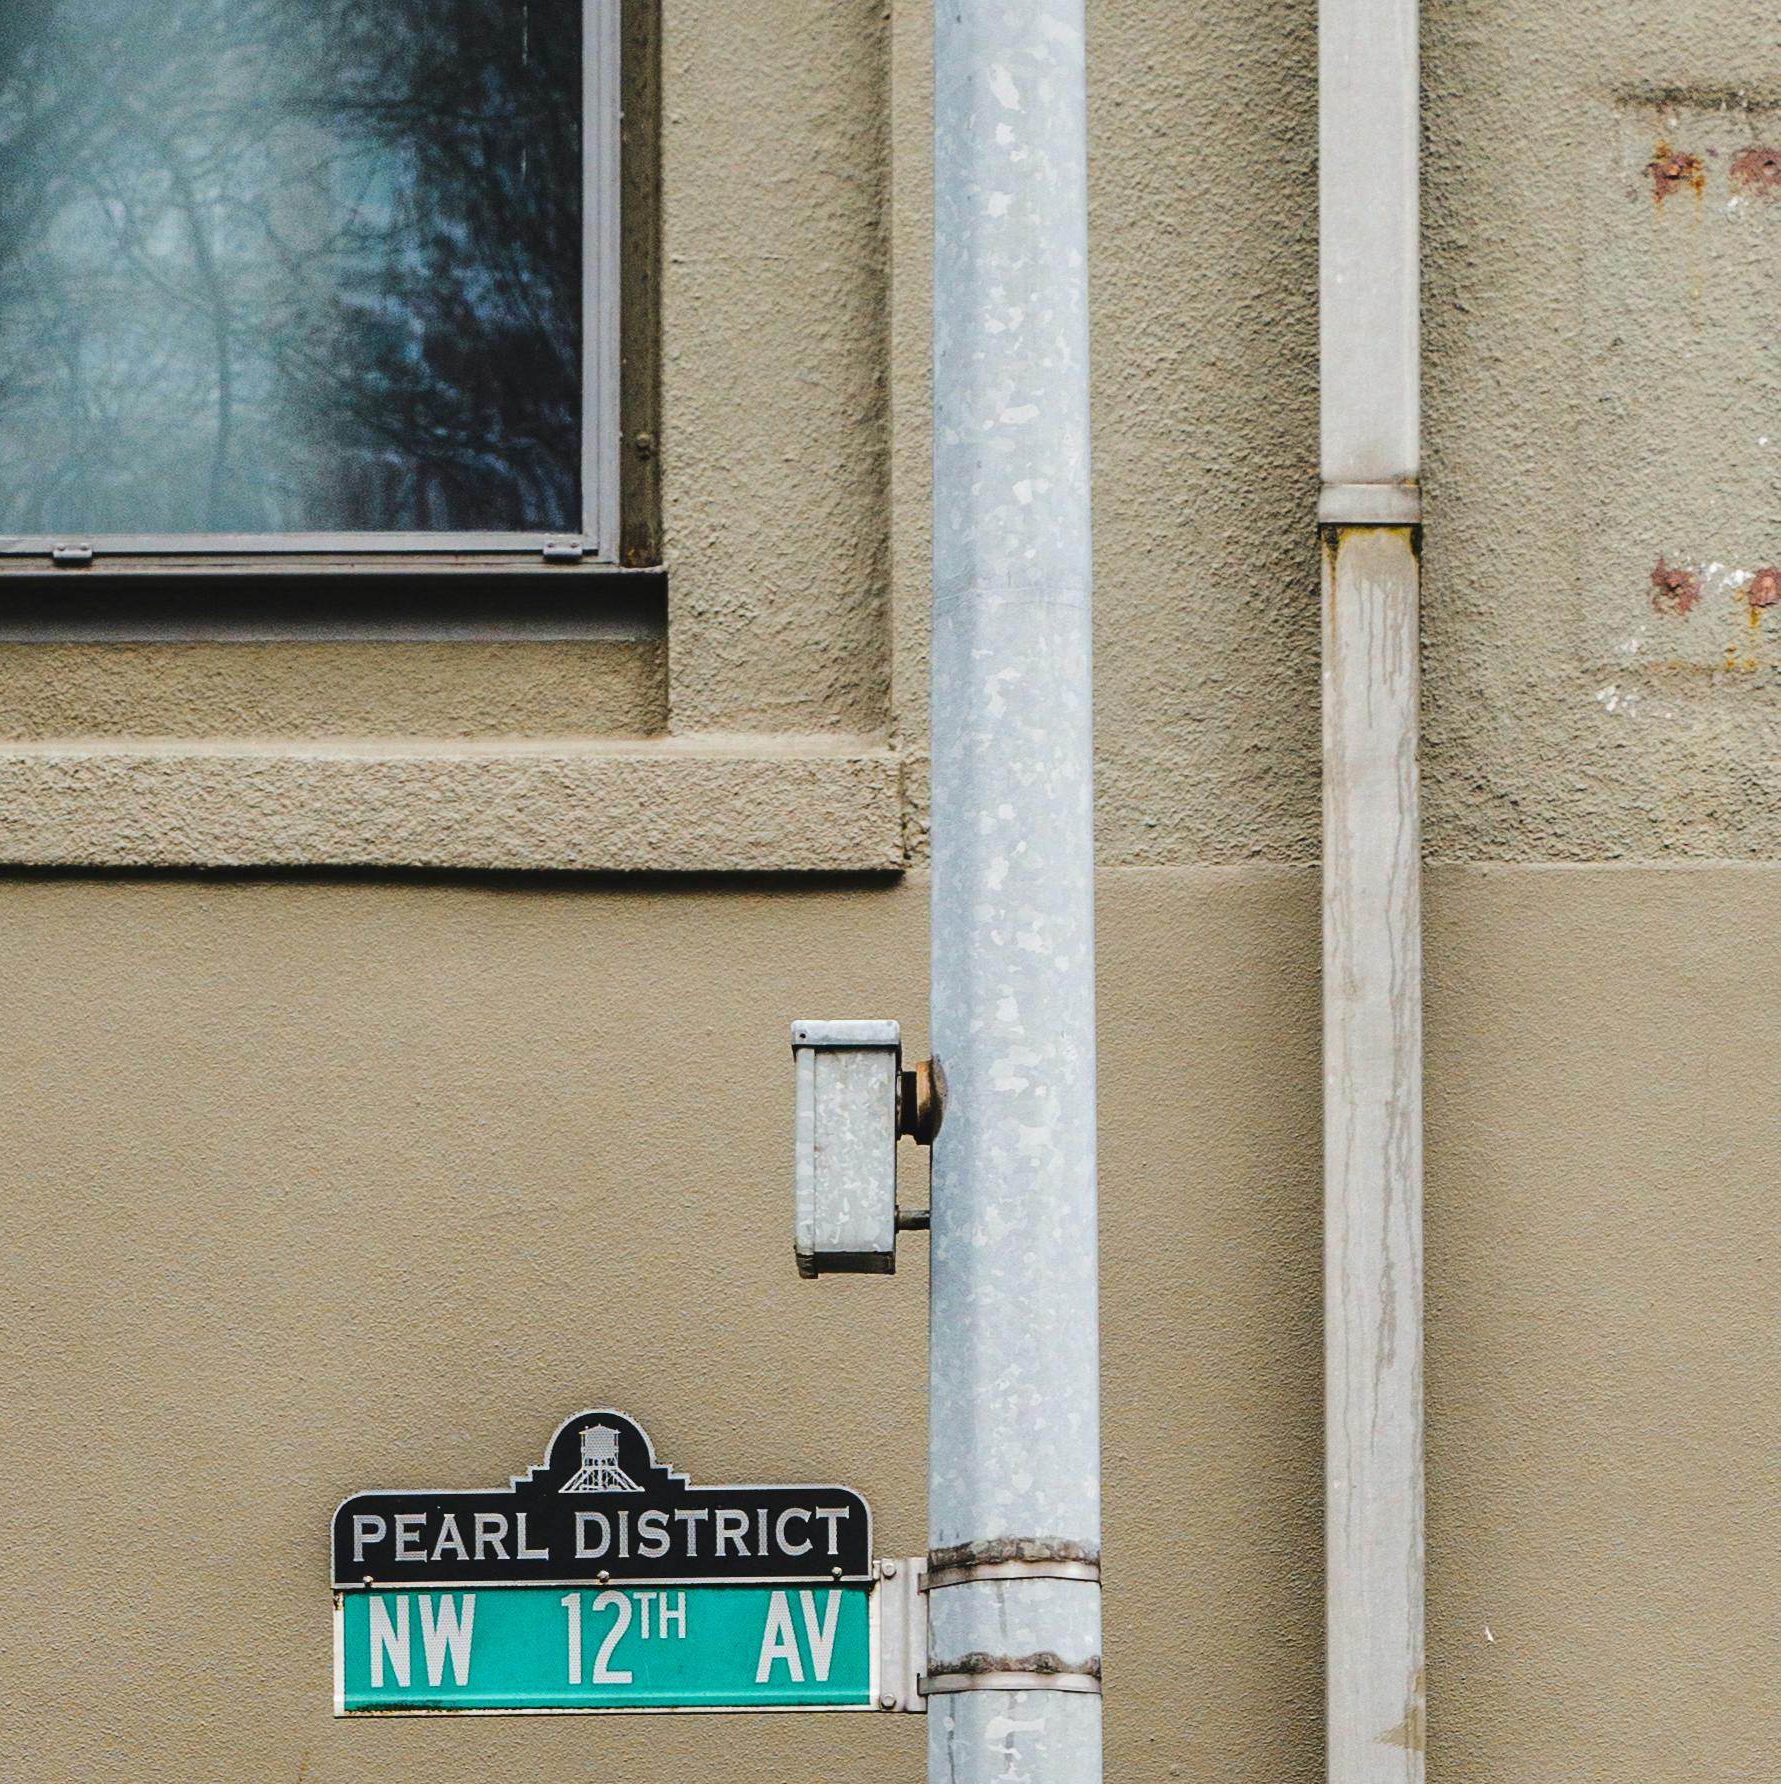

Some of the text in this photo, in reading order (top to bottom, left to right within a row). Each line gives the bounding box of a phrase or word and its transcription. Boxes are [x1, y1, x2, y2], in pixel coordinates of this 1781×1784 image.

[352, 1506, 850, 1563] PEARL DISTRICT
[368, 1589, 843, 1688] NW 12TH AV
